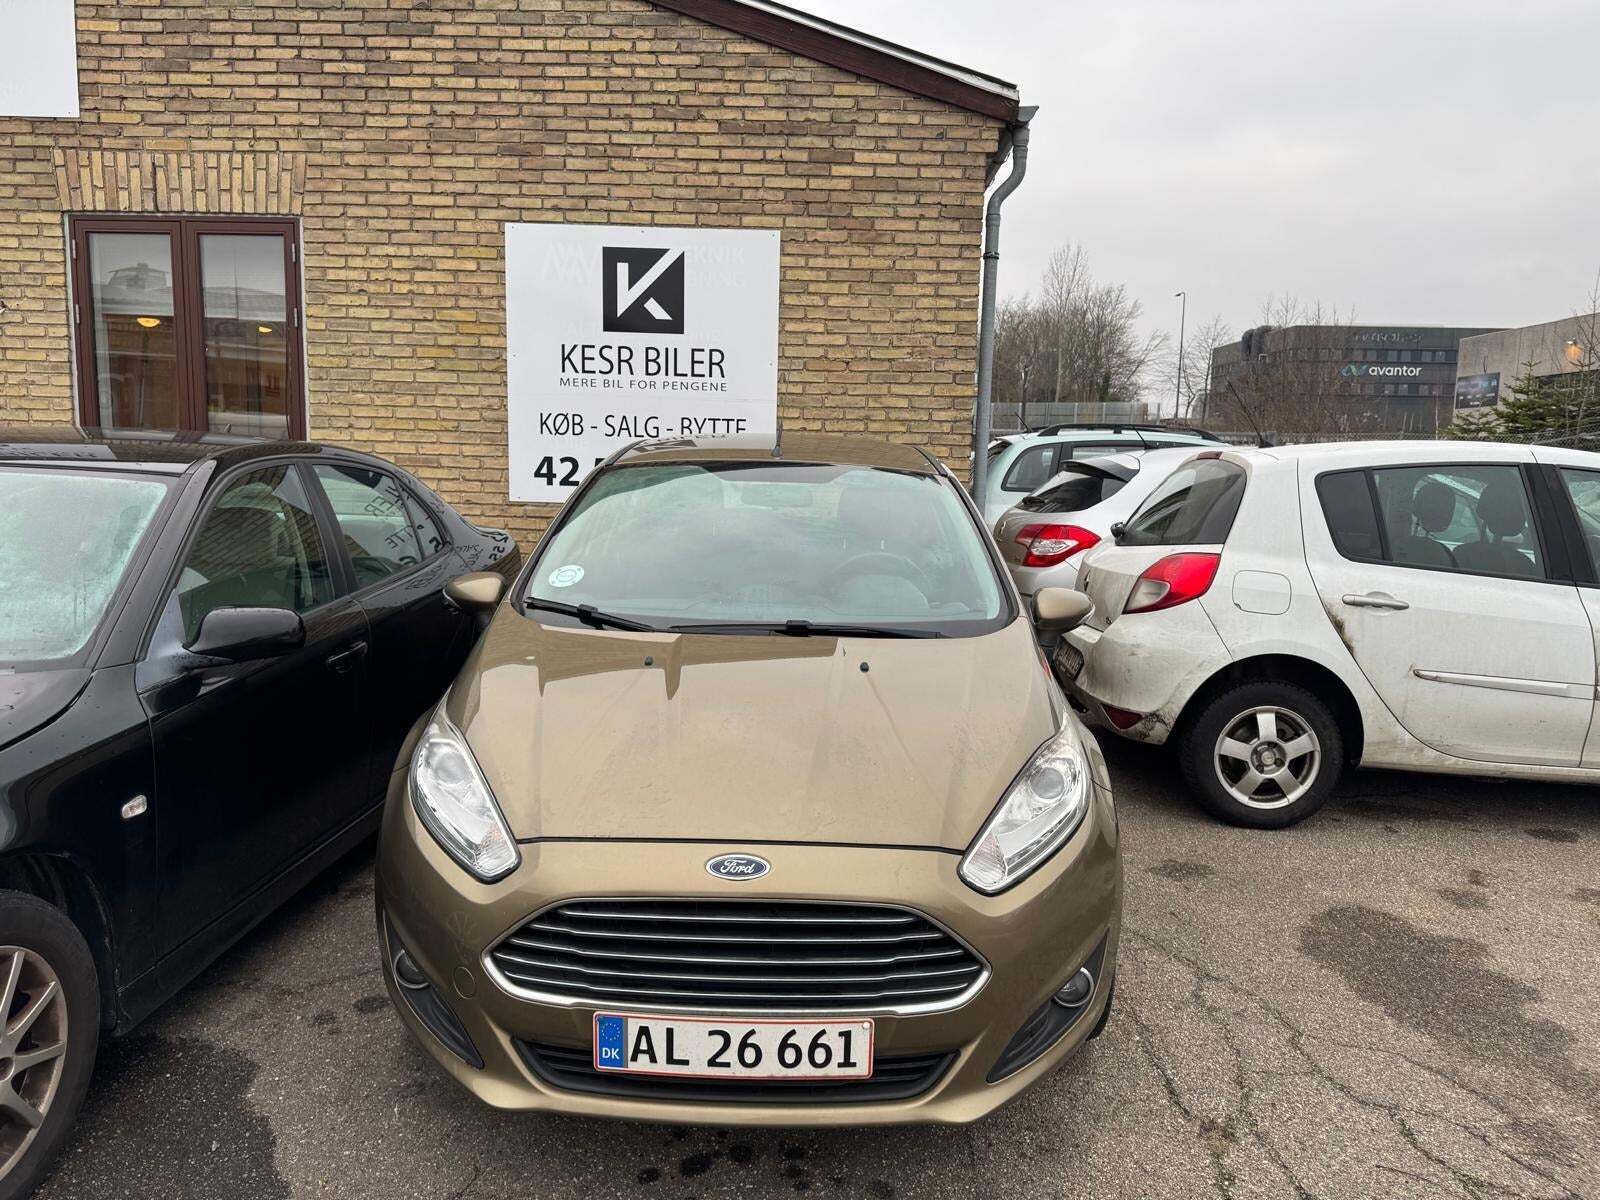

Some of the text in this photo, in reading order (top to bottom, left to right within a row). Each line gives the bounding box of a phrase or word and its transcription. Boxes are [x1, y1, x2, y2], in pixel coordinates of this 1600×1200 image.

[561, 343, 726, 379] KESR BILER
[1368, 365, 1422, 377] avantor
[559, 377, 728, 393] MERE BIL FOR PENGENE
[540, 412, 584, 437] KØB
[604, 414, 660, 438] SALG
[533, 455, 580, 487] 42
[720, 859, 756, 873] Ford
[602, 1047, 620, 1060] DK
[630, 1025, 857, 1069] AL 26 661
